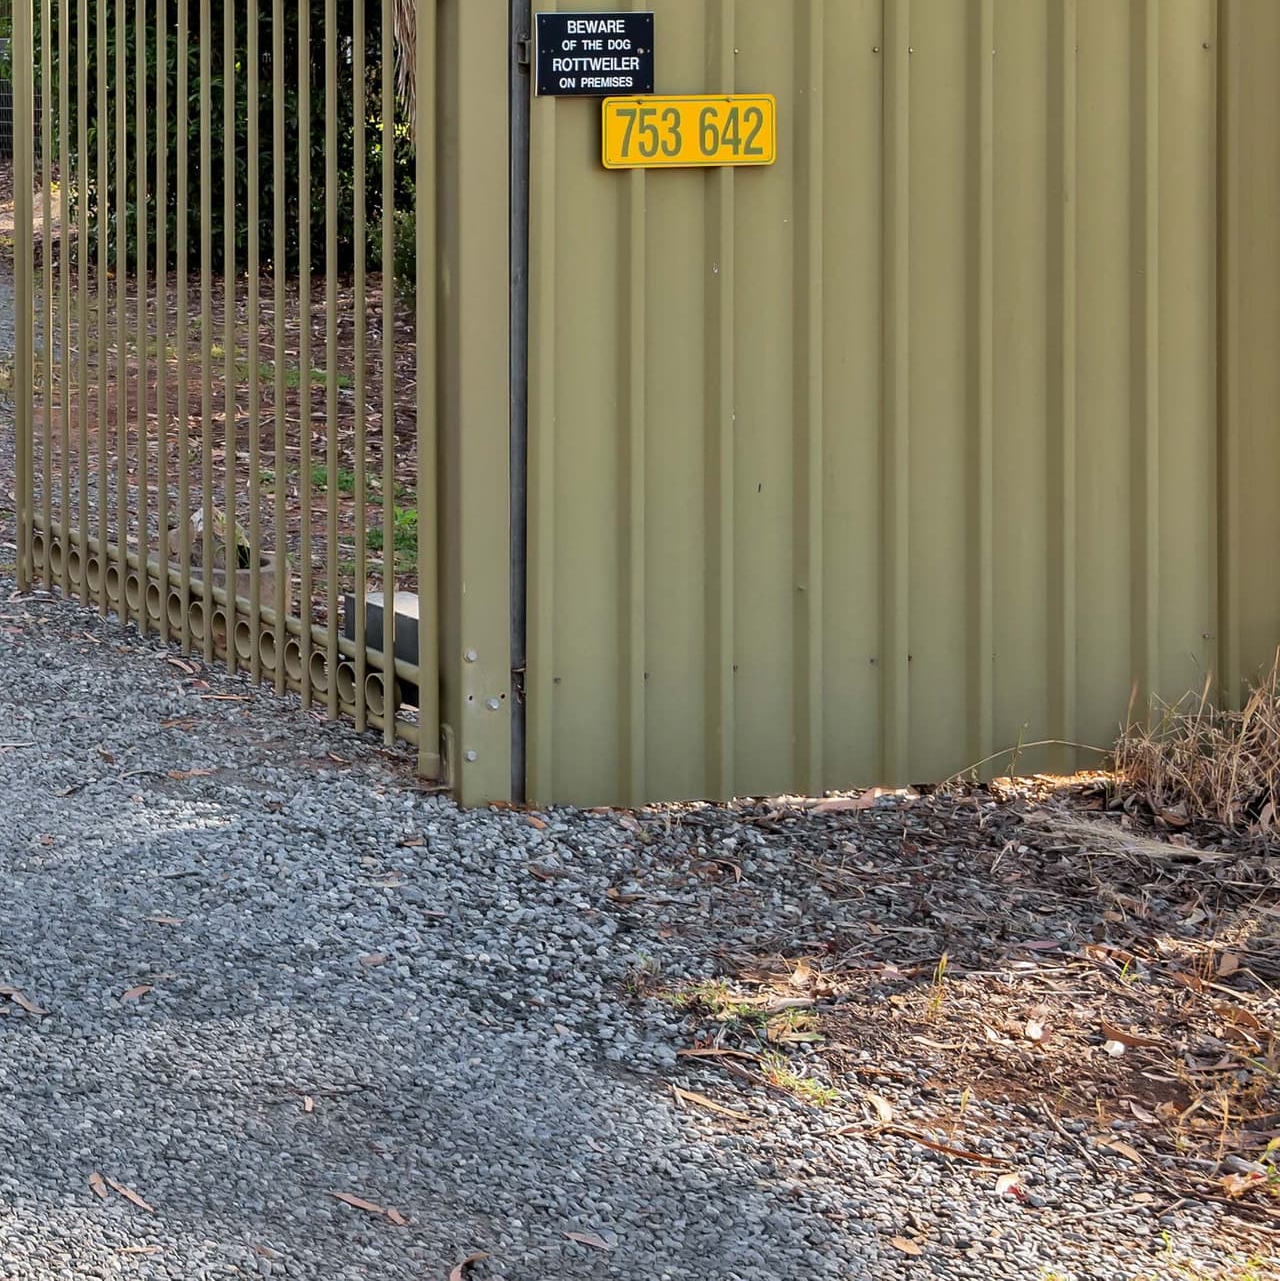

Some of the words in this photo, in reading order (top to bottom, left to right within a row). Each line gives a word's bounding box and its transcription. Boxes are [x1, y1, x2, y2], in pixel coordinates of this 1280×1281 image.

[567, 19, 625, 34] BEWARE
[561, 39, 577, 51] OF
[581, 39, 603, 51] THE
[607, 38, 632, 51] DOG
[552, 56, 640, 72] ROTTWEILER
[559, 77, 576, 89] ON
[580, 76, 633, 88] PREMISES
[615, 107, 682, 158] 753
[698, 106, 764, 156] 642
